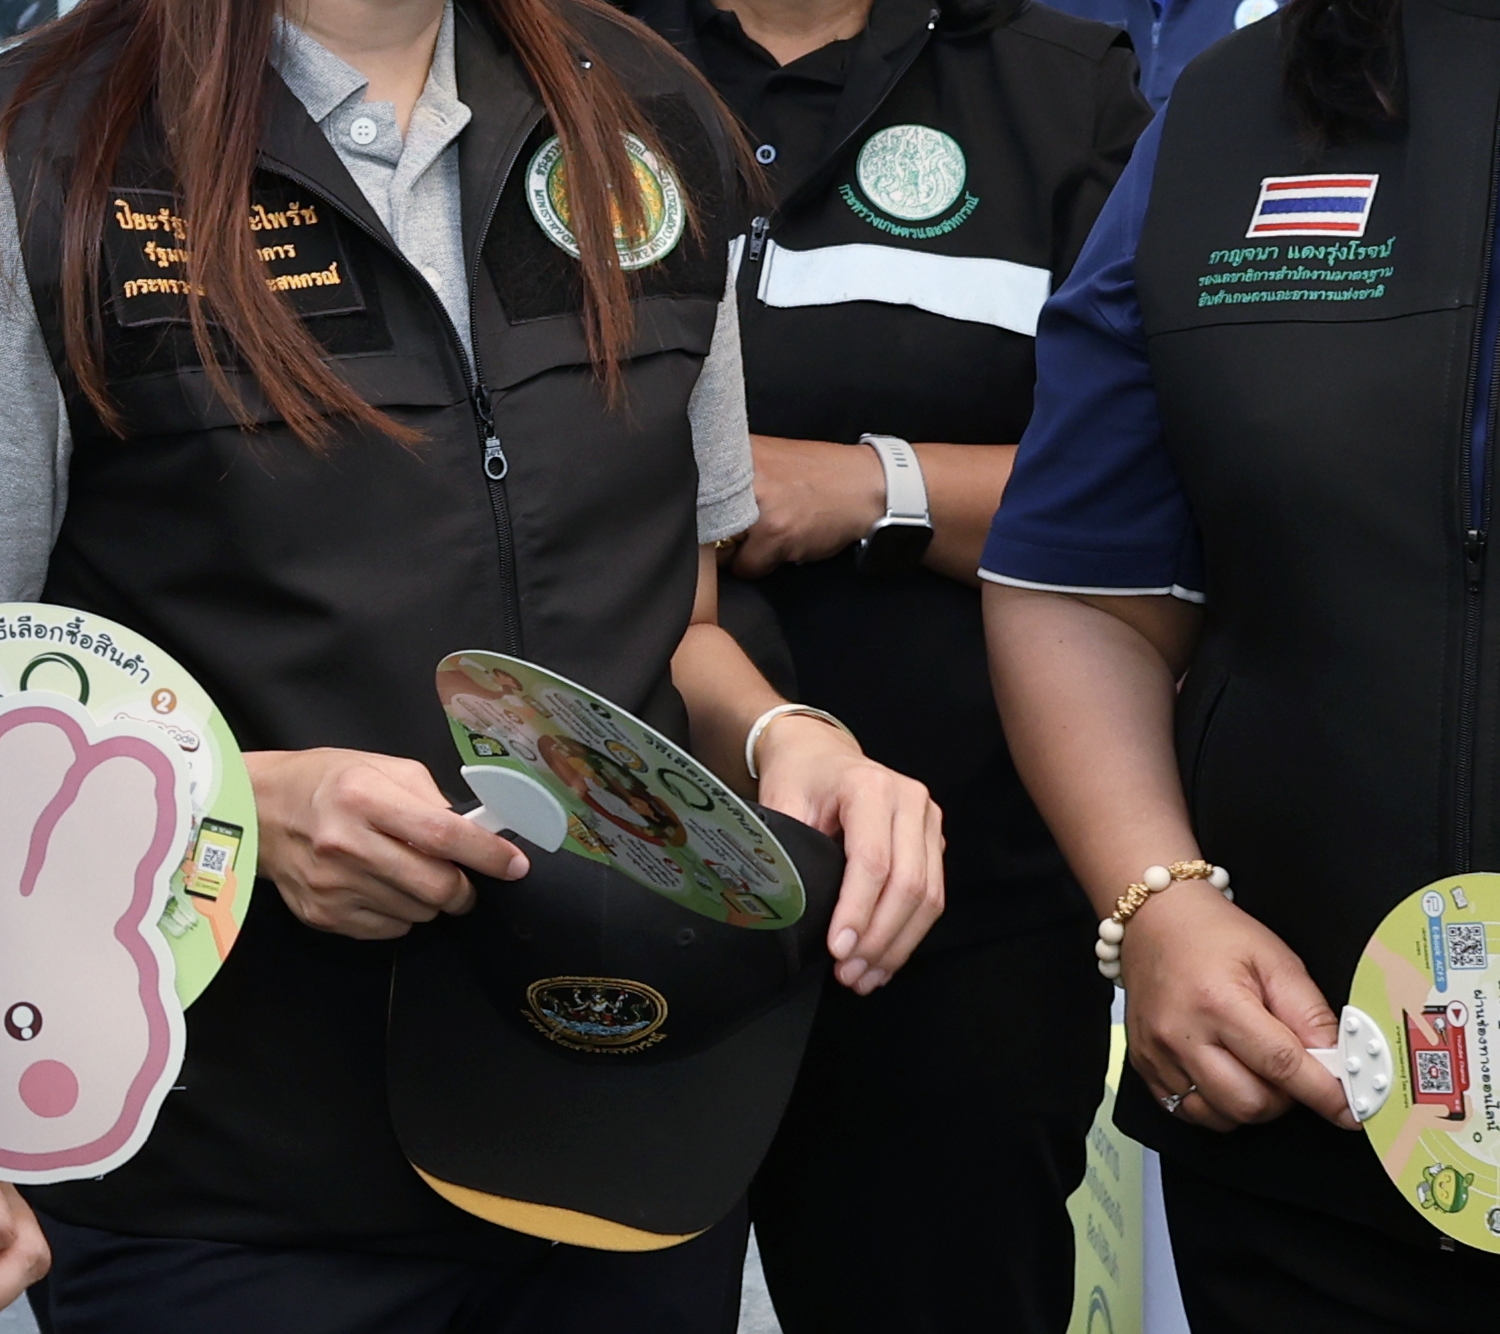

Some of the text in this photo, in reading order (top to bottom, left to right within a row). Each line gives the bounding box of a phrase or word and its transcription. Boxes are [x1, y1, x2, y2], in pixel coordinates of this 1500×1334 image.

[534, 189, 563, 238] MINISTRY
[155, 691, 172, 713] 2
[1431, 926, 1445, 982] E-Book ACFS
[1472, 989, 1499, 1131] ผ่านช่องทางออนไลน์
